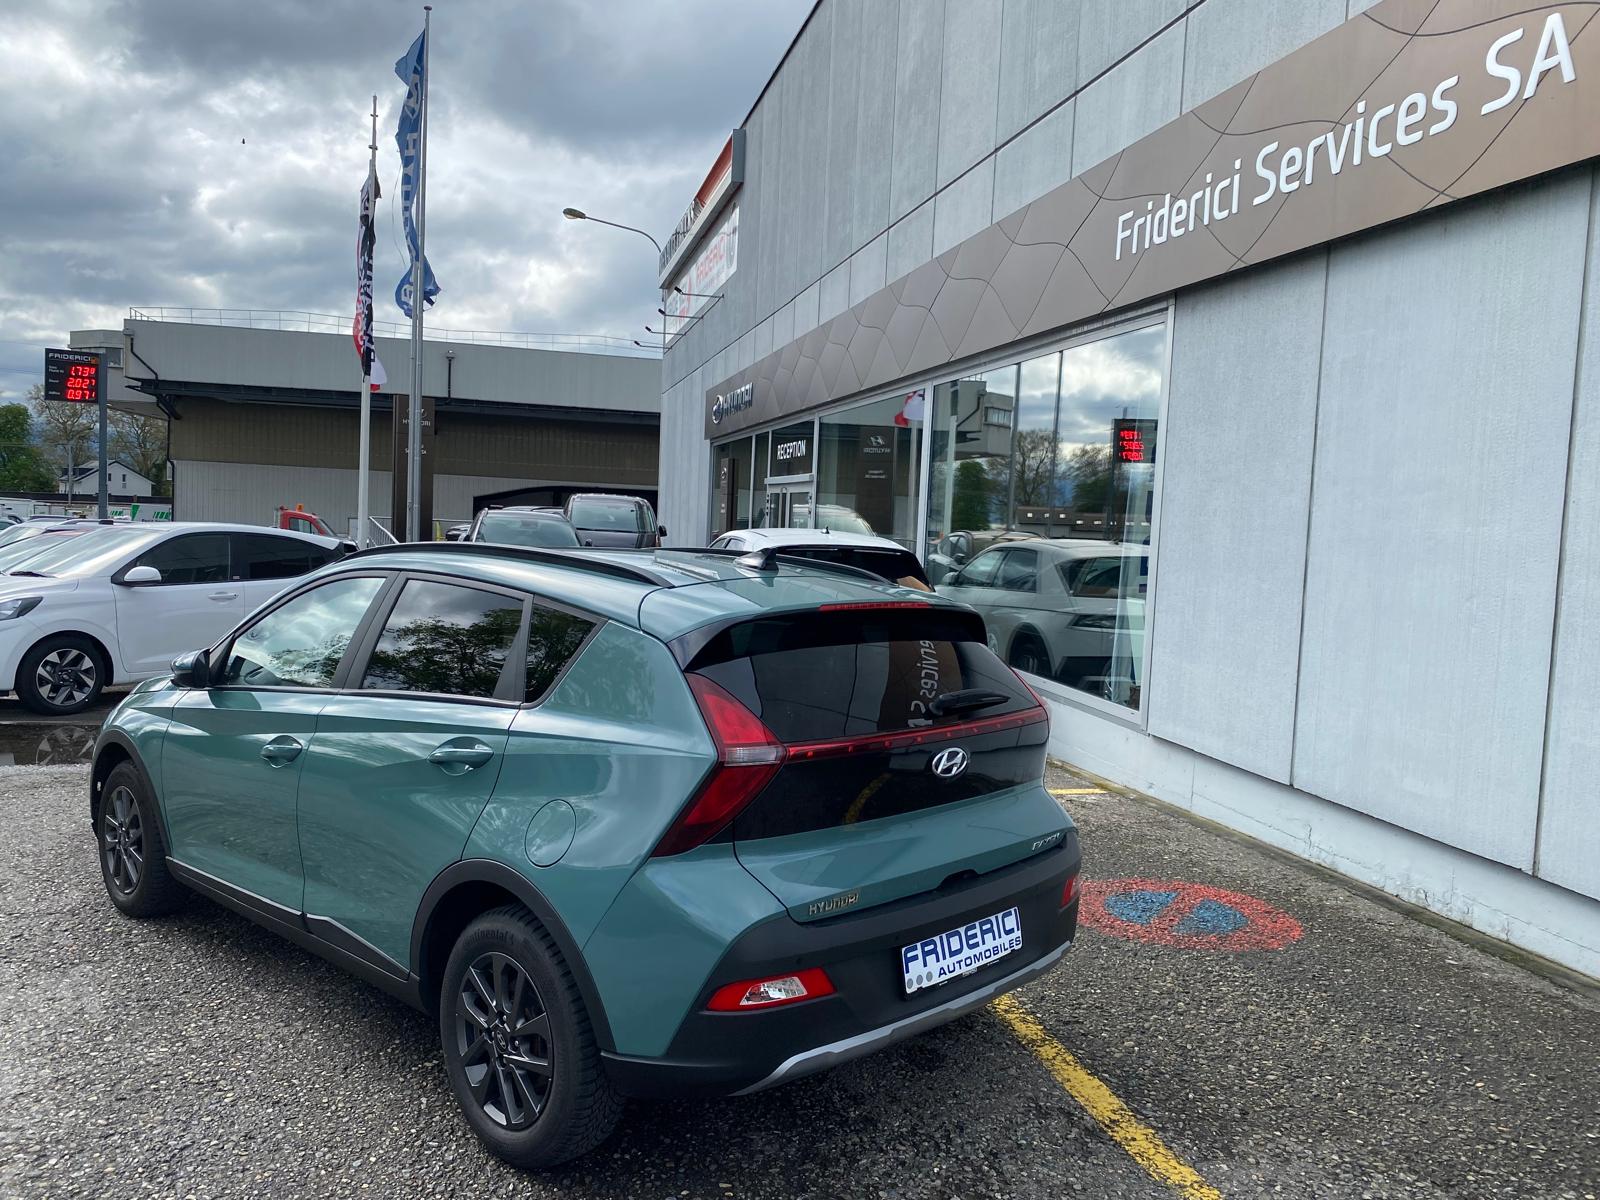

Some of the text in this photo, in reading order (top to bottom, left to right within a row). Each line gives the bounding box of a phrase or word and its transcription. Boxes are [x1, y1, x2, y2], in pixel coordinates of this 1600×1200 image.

[1115, 12, 1578, 261] Friderici Services SA
[48, 352, 91, 362] FRIDERICI
[777, 439, 807, 460] RECEPTION
[809, 892, 859, 916] HYUNDAI
[903, 907, 1020, 974] FRIDERICI
[938, 936, 1022, 978] AUTOMOBILES
